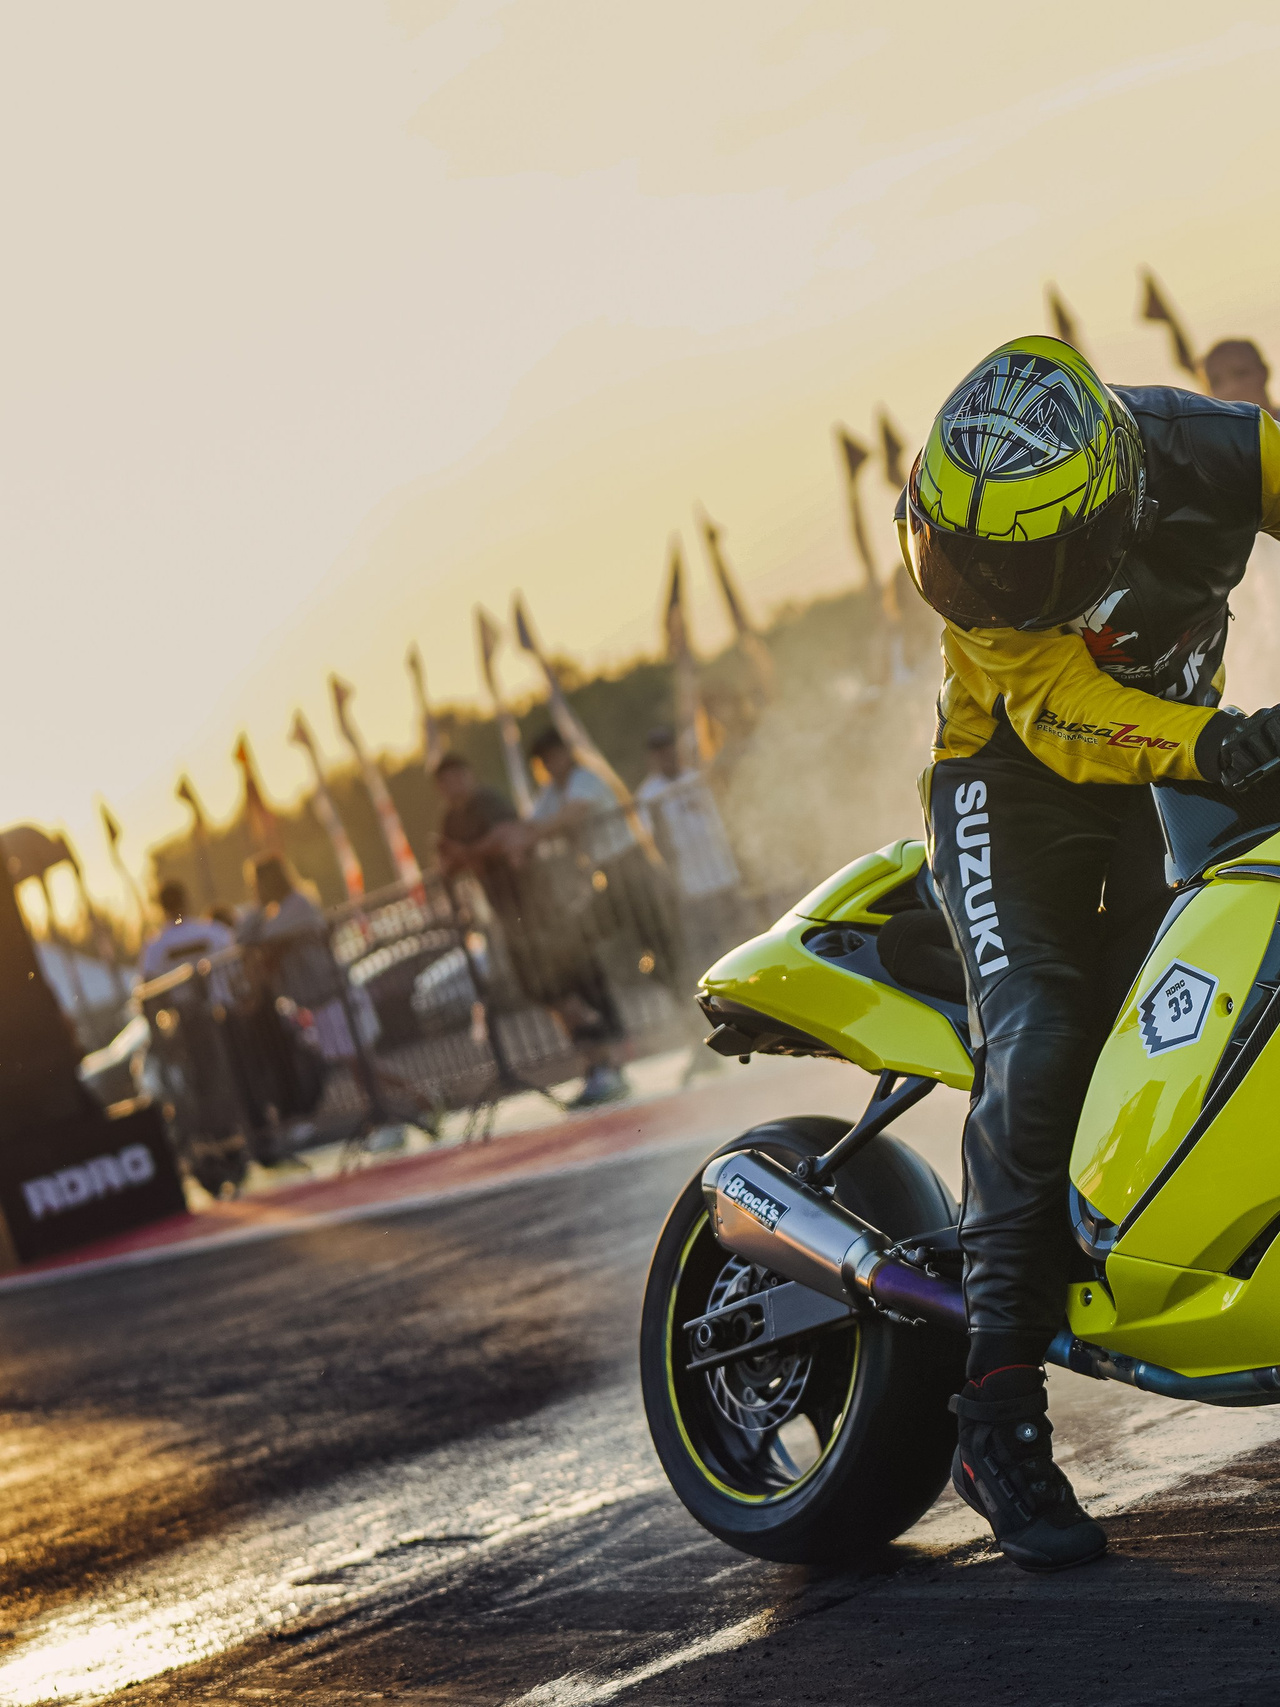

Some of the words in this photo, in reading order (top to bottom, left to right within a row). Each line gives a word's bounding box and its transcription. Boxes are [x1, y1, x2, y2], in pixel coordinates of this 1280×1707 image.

[1036, 724, 1099, 747] PERFORMANCE
[954, 780, 1010, 978] SUZUKI
[1168, 988, 1193, 1023] 33
[726, 1177, 779, 1221] Brock's
[734, 1198, 773, 1227] PERFORMANCE
